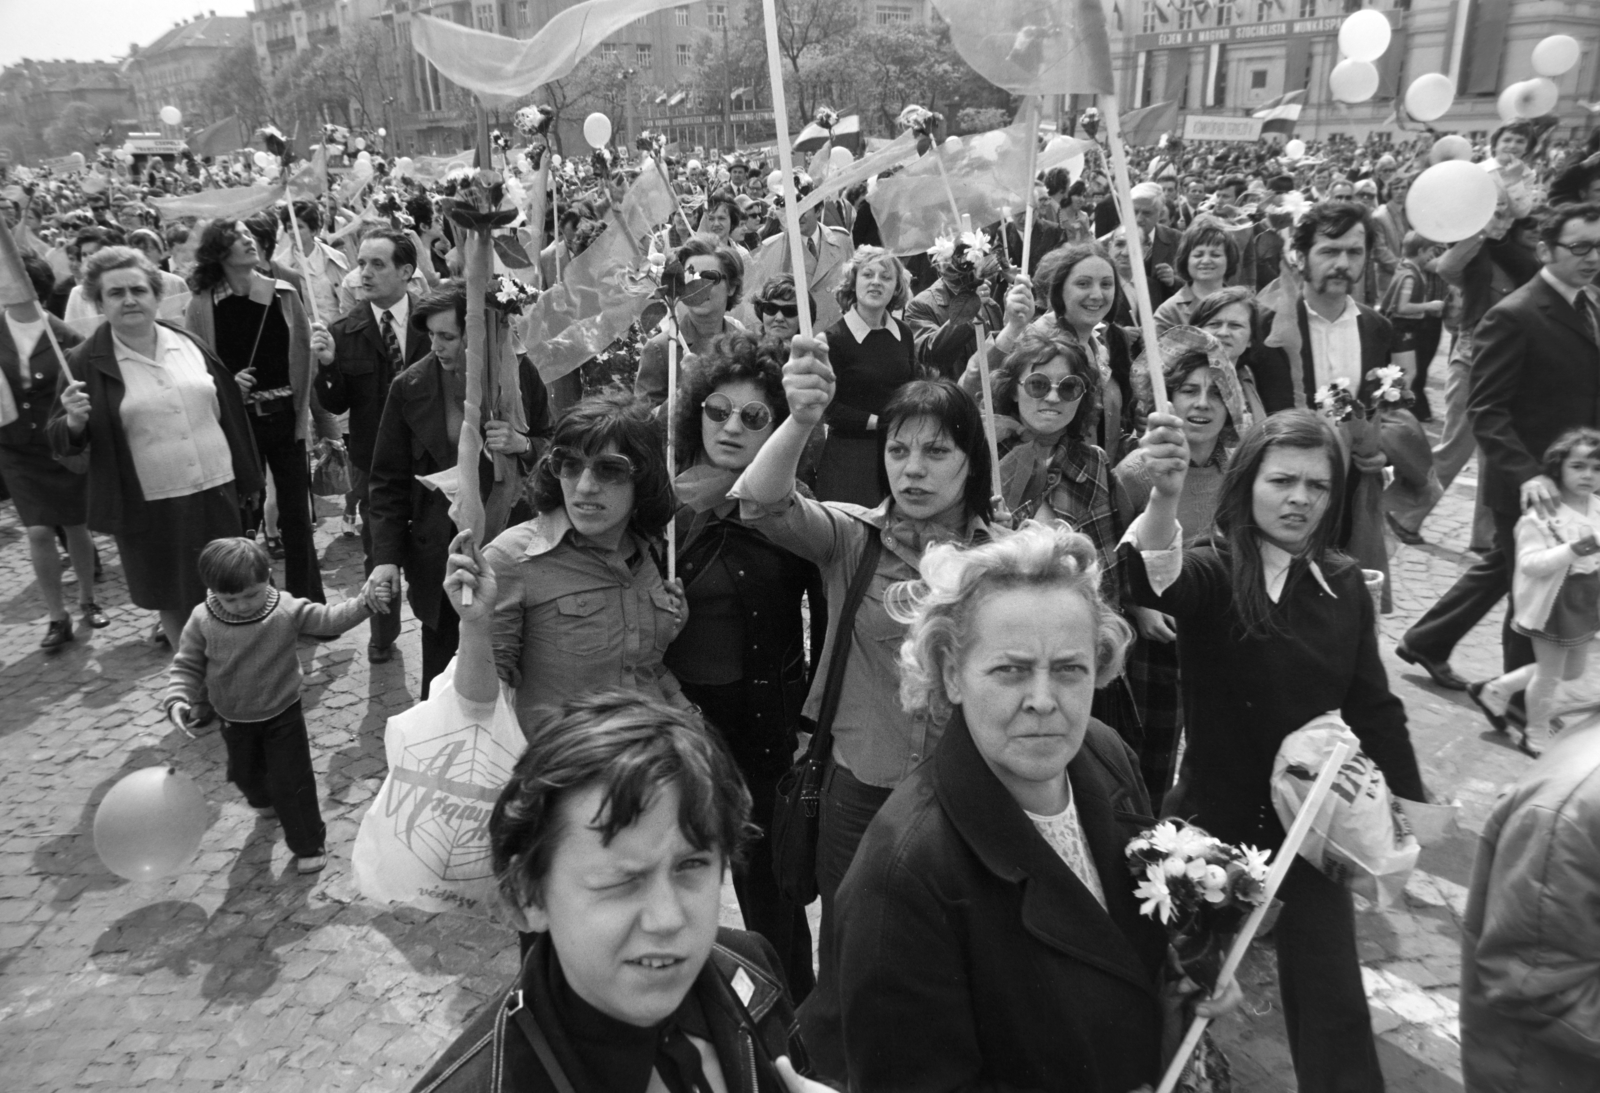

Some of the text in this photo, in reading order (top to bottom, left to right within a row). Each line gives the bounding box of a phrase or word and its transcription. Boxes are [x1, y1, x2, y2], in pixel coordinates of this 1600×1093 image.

[1158, 17, 1346, 46] ÉLJEN A MAGYAR SZOCIALISTA MUNKÁSPÁ
[417, 885, 479, 910] védjegy
